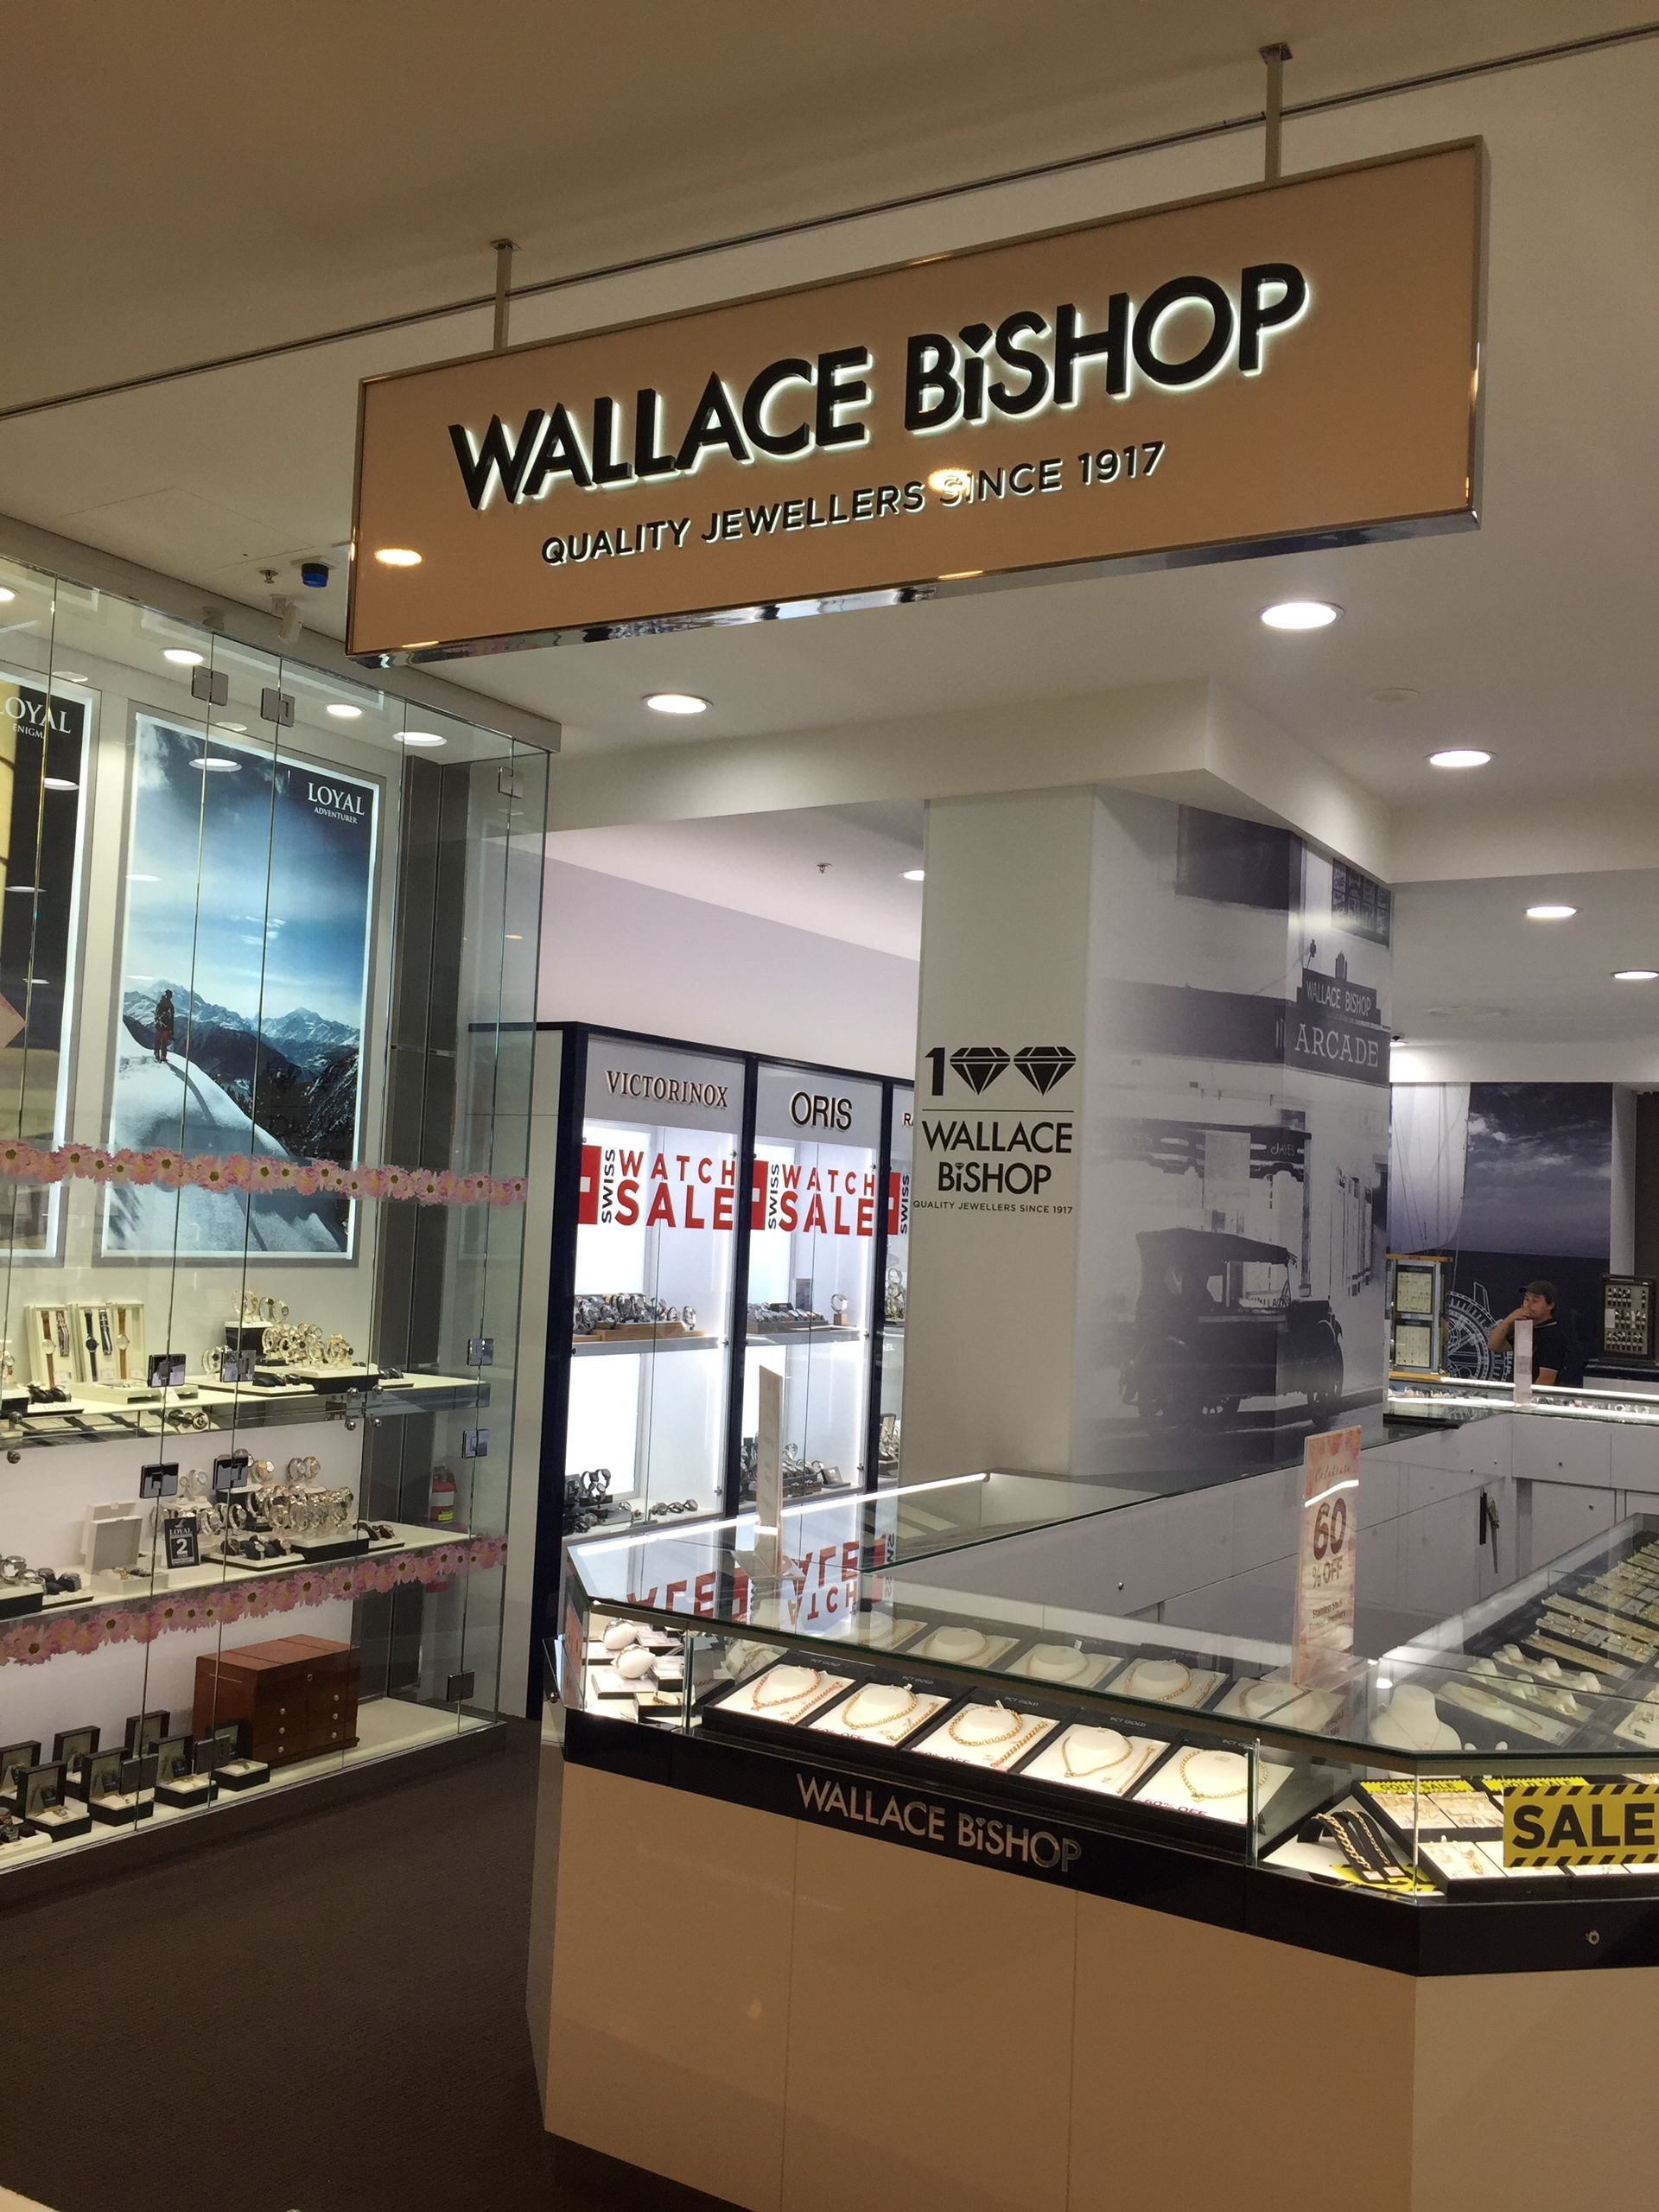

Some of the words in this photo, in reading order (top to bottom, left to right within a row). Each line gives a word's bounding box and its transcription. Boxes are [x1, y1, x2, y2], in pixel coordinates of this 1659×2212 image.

[448, 346, 870, 510] WALLACE
[542, 518, 690, 565] QUALITY
[702, 481, 925, 542] JEWELLERS
[940, 458, 1063, 506] SINCE
[1077, 441, 1166, 484] 1917
[0, 696, 71, 734] OYAL
[13, 723, 45, 739] ENIGM
[308, 782, 365, 816] LOYAL
[314, 806, 359, 824] ADVENTURER
[1306, 980, 1341, 1009] WALLACE
[1344, 991, 1371, 1017] BISHOP
[1294, 1023, 1379, 1067] ARCADE
[606, 1070, 728, 1109] VICTORINOX
[790, 1091, 853, 1131] ORIS
[922, 1120, 1072, 1154] WALLACE
[619, 1148, 735, 1185] WATCH
[782, 1163, 875, 1197] WATCH
[601, 1149, 616, 1224] SWISS
[614, 1179, 734, 1230] SALE
[768, 1163, 779, 1230] SWISS
[899, 1174, 910, 1234] SWISS
[779, 1191, 874, 1236] SALE
[913, 1200, 955, 1209] QUALITY
[958, 1202, 1016, 1212] JEWELLERS
[1020, 1204, 1049, 1213] SINCE
[1052, 1205, 1073, 1214] 1917
[175, 1538, 188, 1554] 2
[1313, 1497, 1347, 1560] 60
[1323, 1556, 1344, 1584] OFF
[797, 1772, 946, 1841] WALLACE
[1512, 1802, 1656, 1851] SALE
